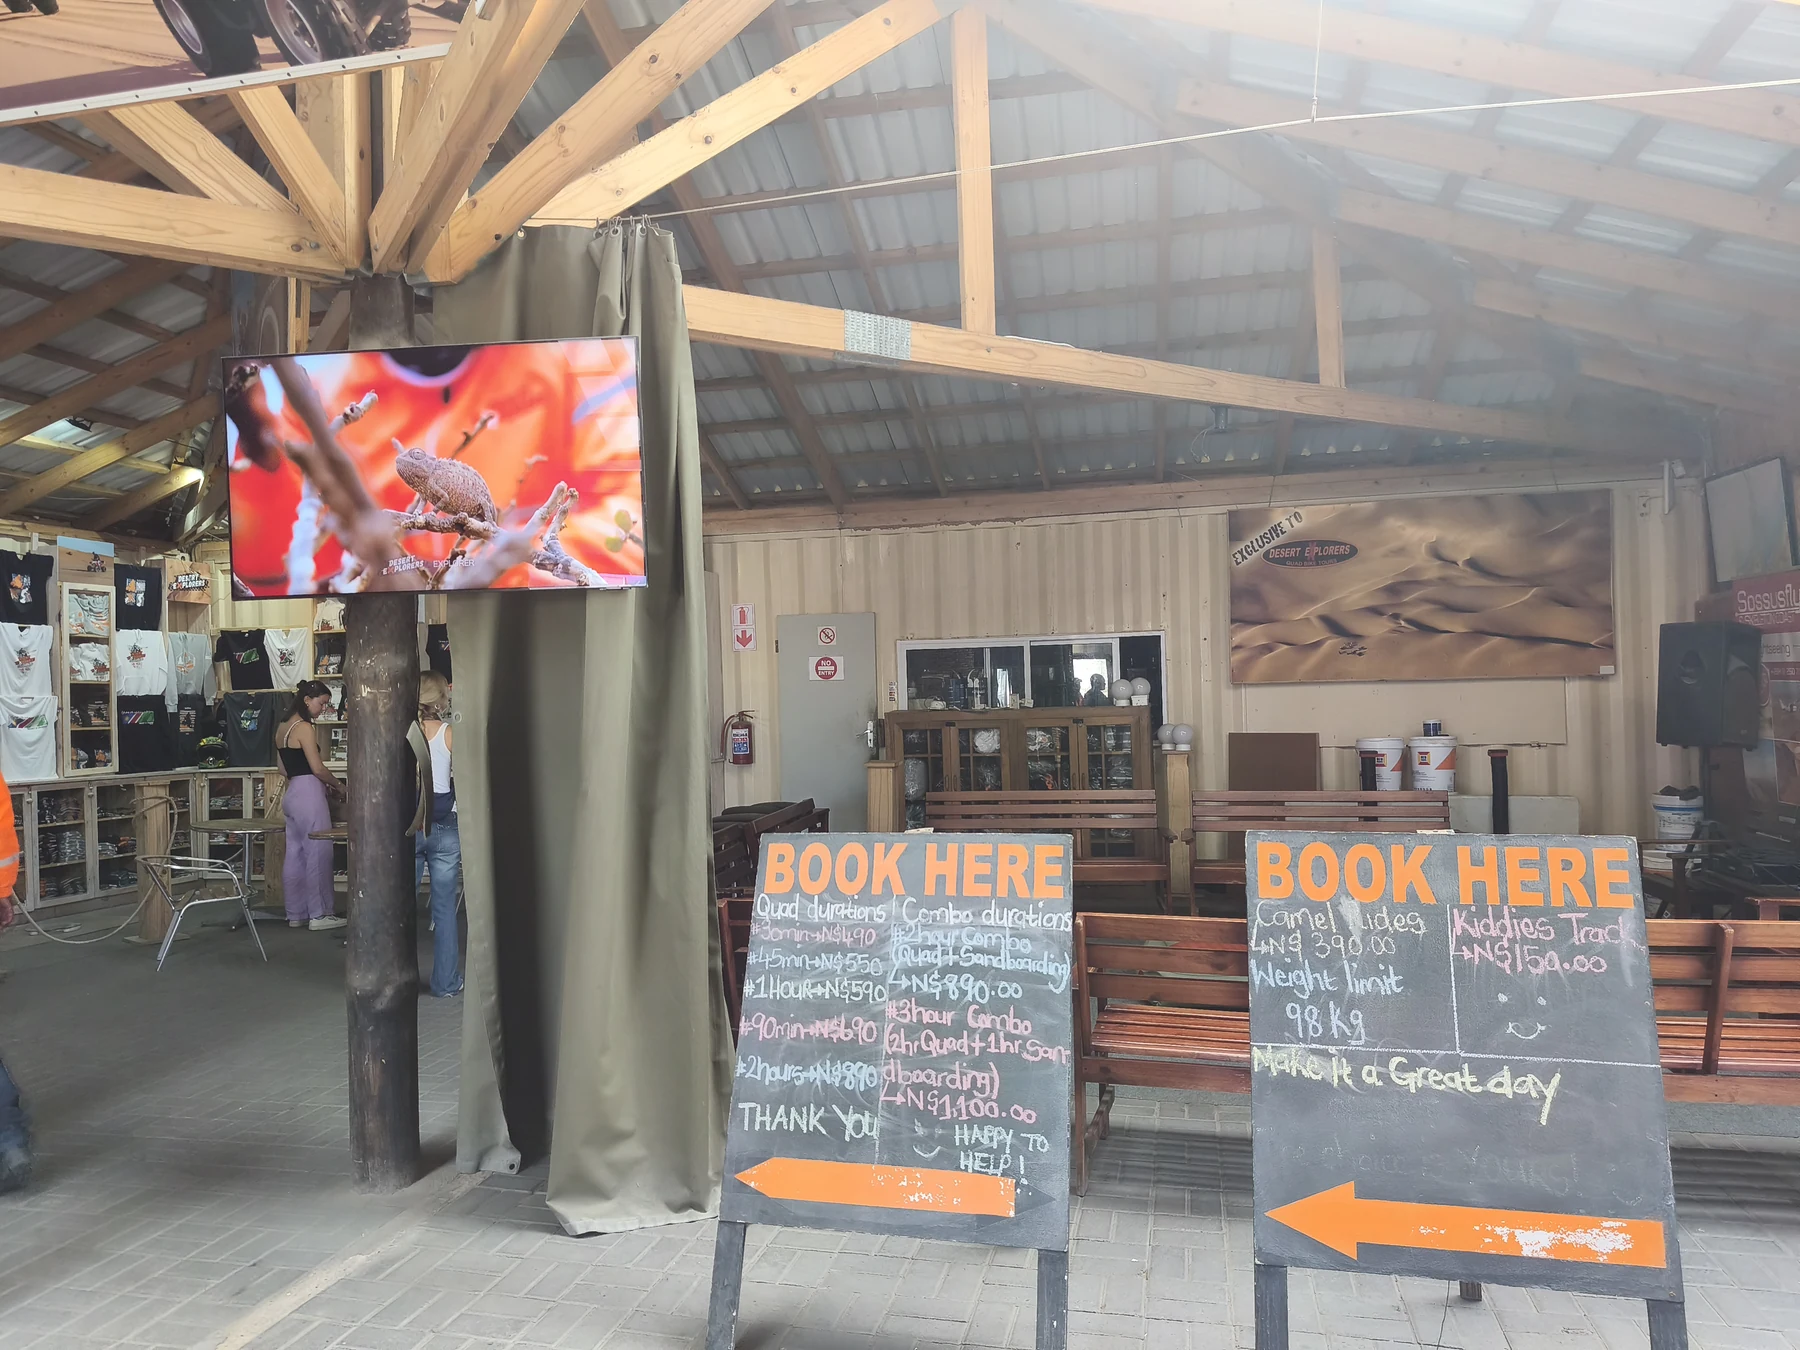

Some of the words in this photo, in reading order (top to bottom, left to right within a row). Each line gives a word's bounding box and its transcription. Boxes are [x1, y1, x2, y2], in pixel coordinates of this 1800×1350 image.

[1232, 521, 1287, 566] EXCLUSIVE
[1285, 511, 1303, 529] TO
[1269, 547, 1302, 559] DESERT
[1305, 541, 1351, 561] EXPLORERS
[382, 560, 424, 575] EXPLORERS
[389, 555, 416, 567] DESERT
[433, 560, 475, 568] EXPLORER
[764, 842, 909, 895] BOOK
[924, 843, 1064, 899] HERE
[1257, 842, 1437, 904] BOOK
[1457, 846, 1635, 909] HERE
[757, 893, 800, 921] Quad
[807, 893, 887, 922] durations
[902, 896, 974, 925] Combo
[981, 899, 1072, 932] durations
[1256, 900, 1336, 933] Camel
[961, 927, 1032, 954] Combo
[1453, 905, 1555, 948] Kiddies
[1250, 957, 1338, 999] Weight
[1343, 960, 1404, 995] limit
[966, 1004, 1032, 1035] Combo
[1252, 1045, 1323, 1081] Make
[1361, 1065, 1384, 1087] a
[1388, 1056, 1483, 1093] Great
[1487, 1065, 1562, 1125] day
[738, 1102, 828, 1135] THANK
[954, 1124, 1014, 1153] HAPPY
[1020, 1132, 1050, 1153] TO
